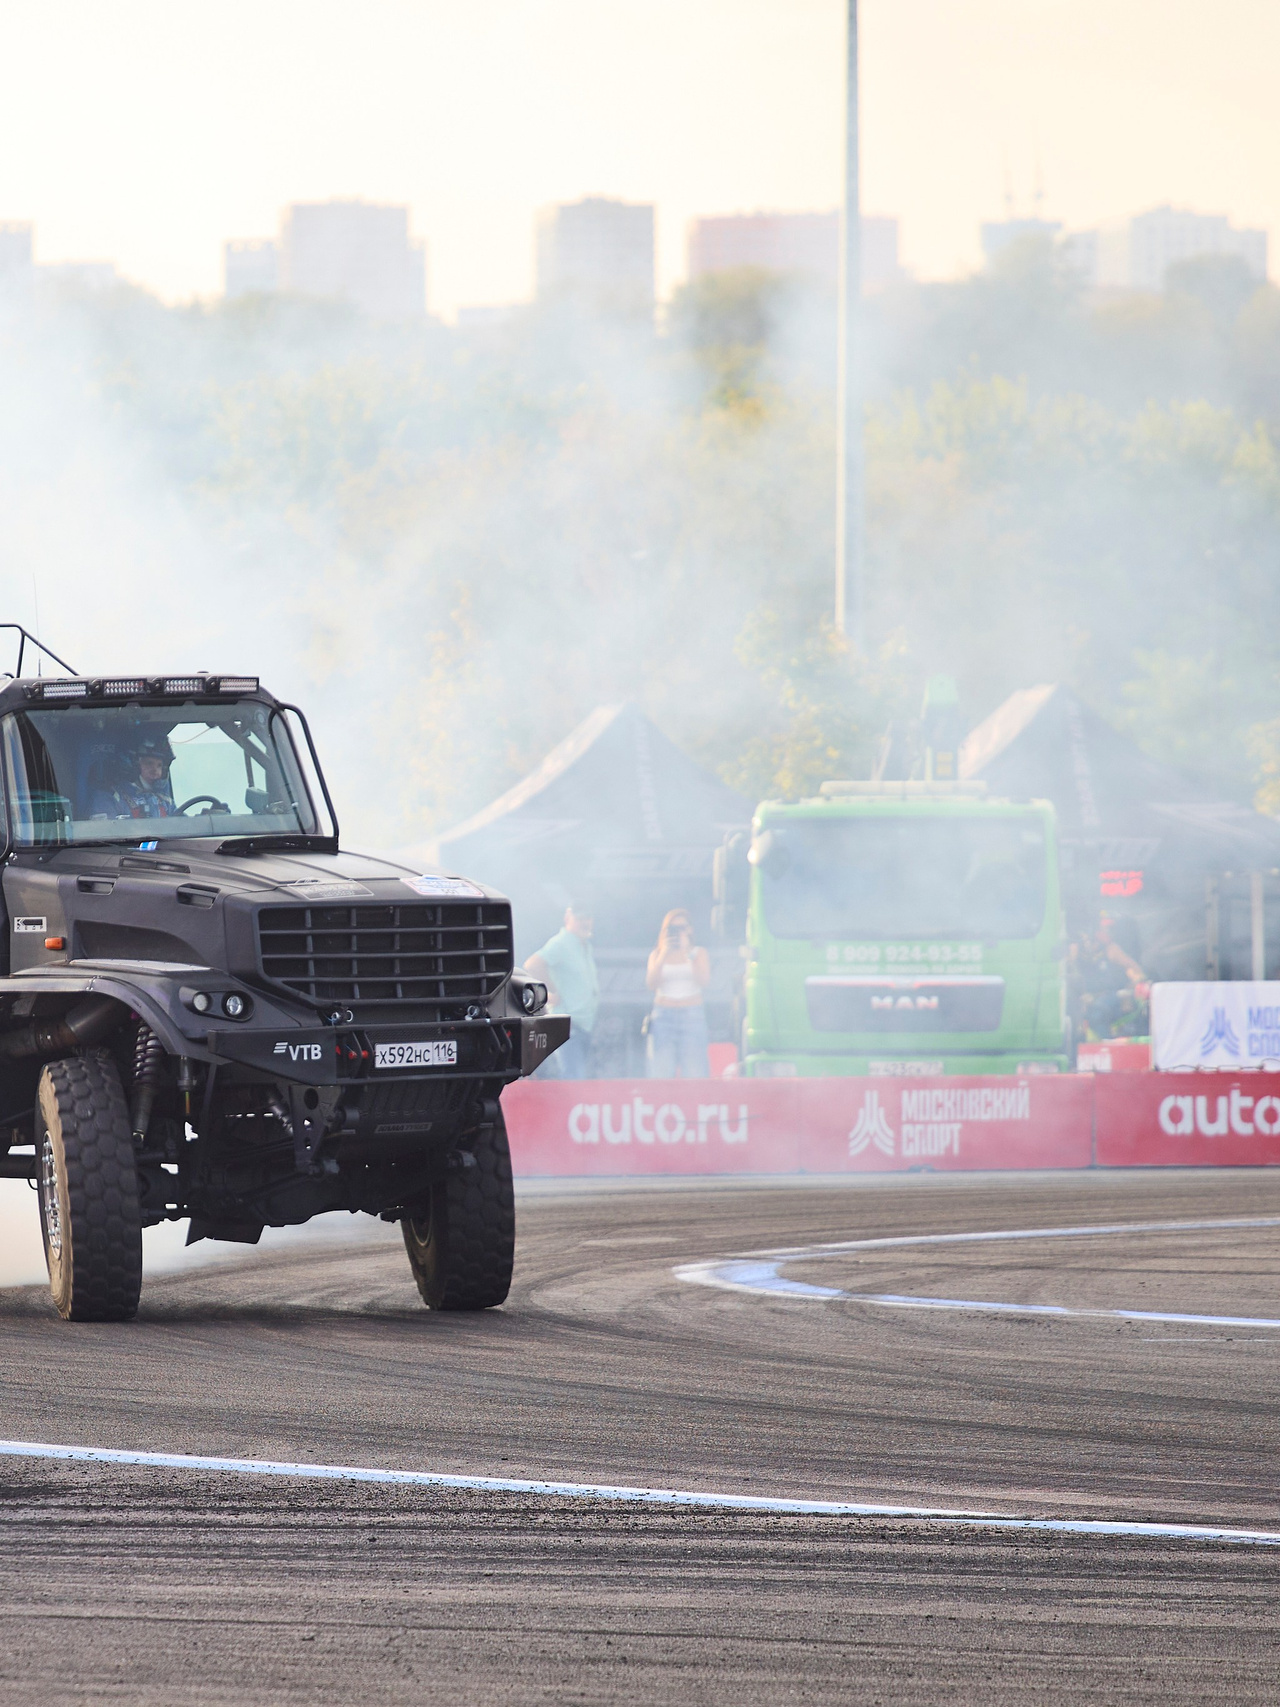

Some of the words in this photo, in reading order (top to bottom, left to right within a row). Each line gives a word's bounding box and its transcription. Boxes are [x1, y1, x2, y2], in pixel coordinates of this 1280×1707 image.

[871, 996, 939, 1010] MAN
[534, 1033, 548, 1048] VTB
[288, 1044, 322, 1061] VTB
[434, 1043, 453, 1057] 116
[901, 1082, 1030, 1122] МОСКОВСКИЙ
[568, 1096, 748, 1144] auto.ru
[901, 1123, 962, 1157] СПОРТ
